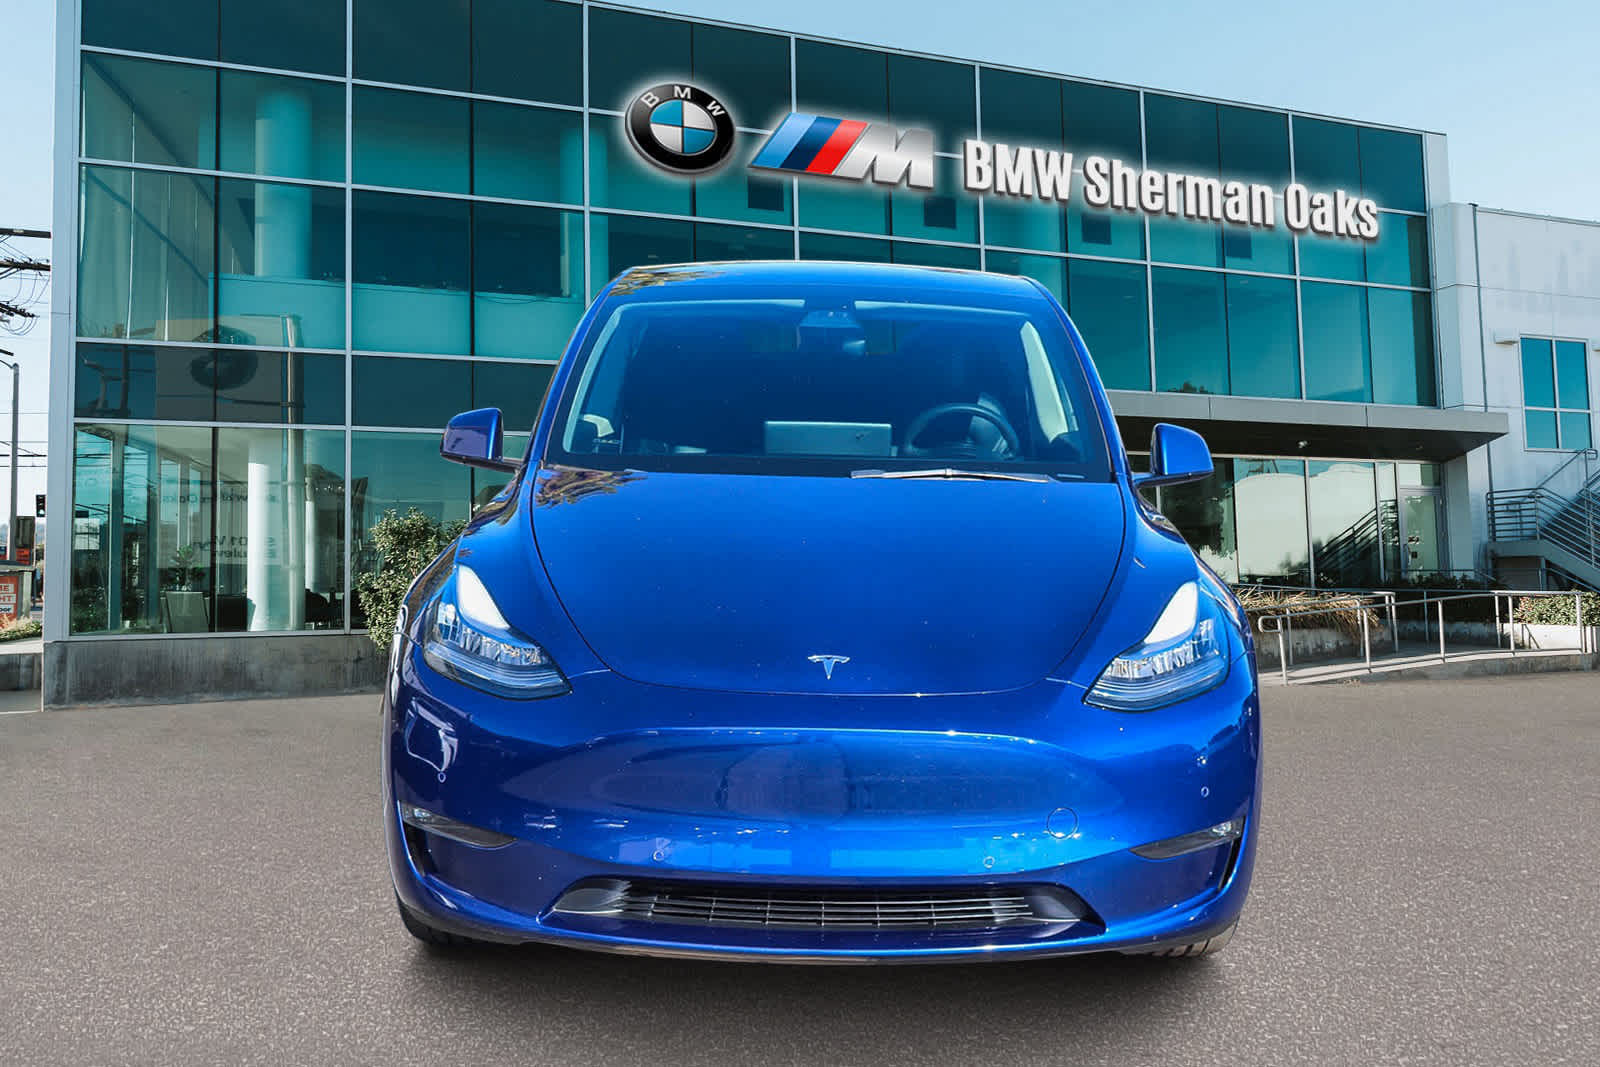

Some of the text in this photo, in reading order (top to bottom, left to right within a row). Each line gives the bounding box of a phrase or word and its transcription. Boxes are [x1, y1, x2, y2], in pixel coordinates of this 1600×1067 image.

[641, 86, 726, 117] BMW
[964, 139, 1380, 240] BMW Sherman Oaks
